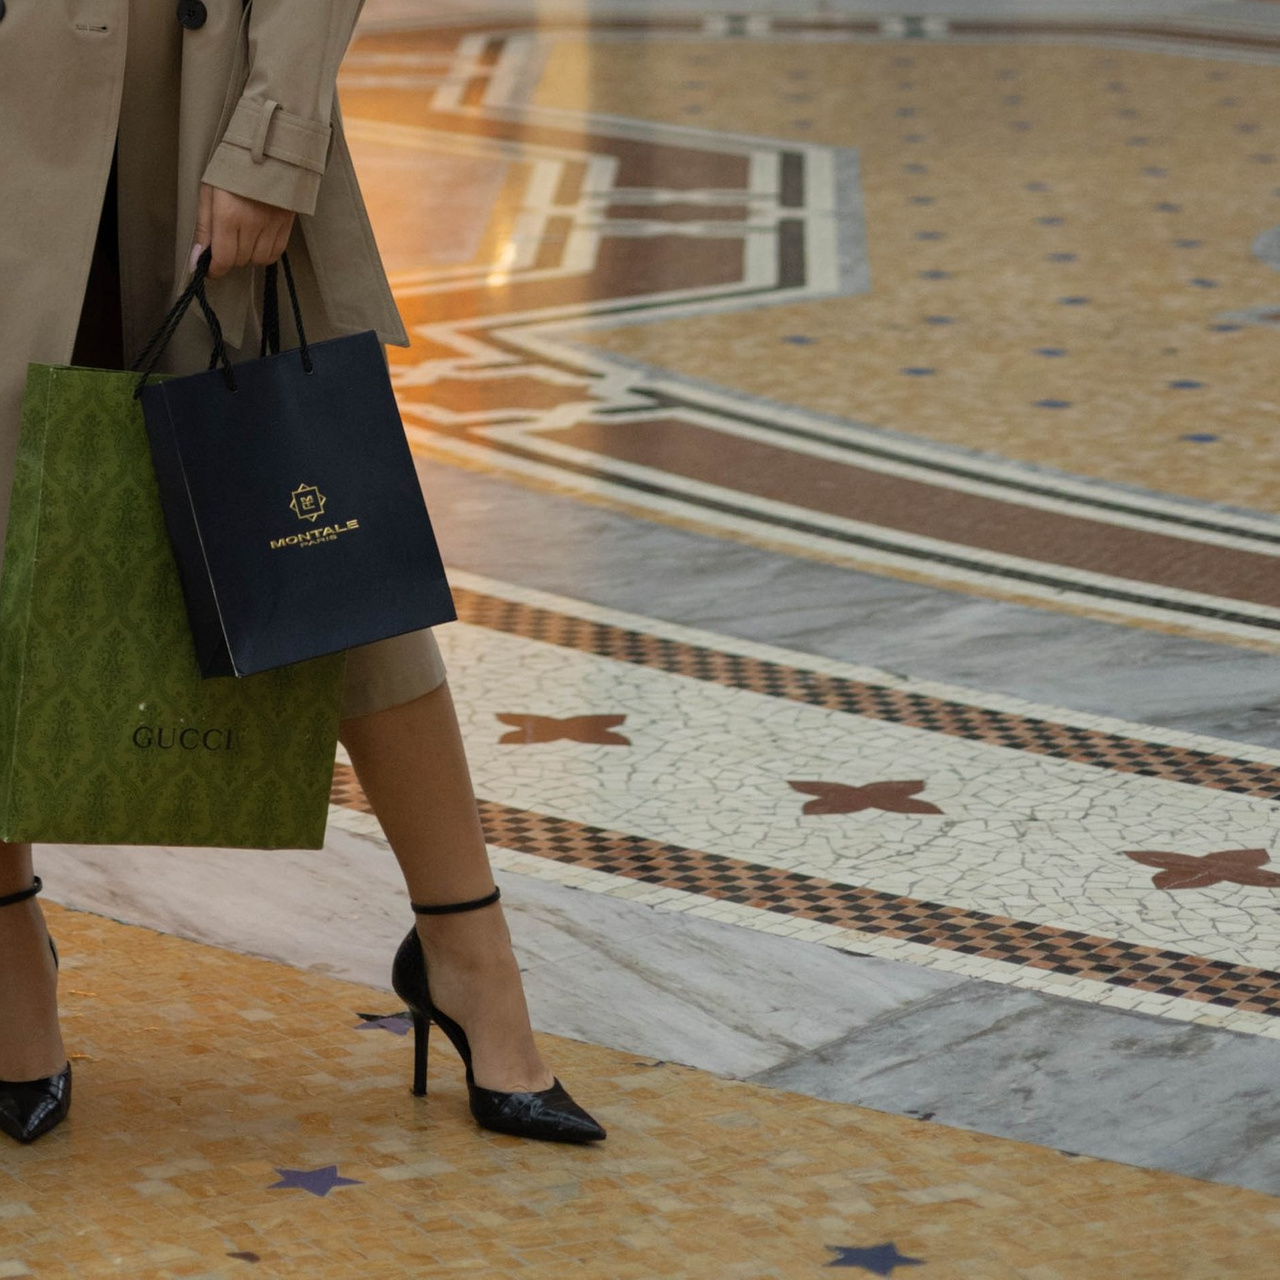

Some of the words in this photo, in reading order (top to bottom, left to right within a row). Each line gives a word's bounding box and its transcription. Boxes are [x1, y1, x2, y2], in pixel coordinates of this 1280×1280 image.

[270, 519, 359, 549] MONTALE
[300, 534, 337, 548] PARIS
[132, 726, 233, 751] GUCCI
